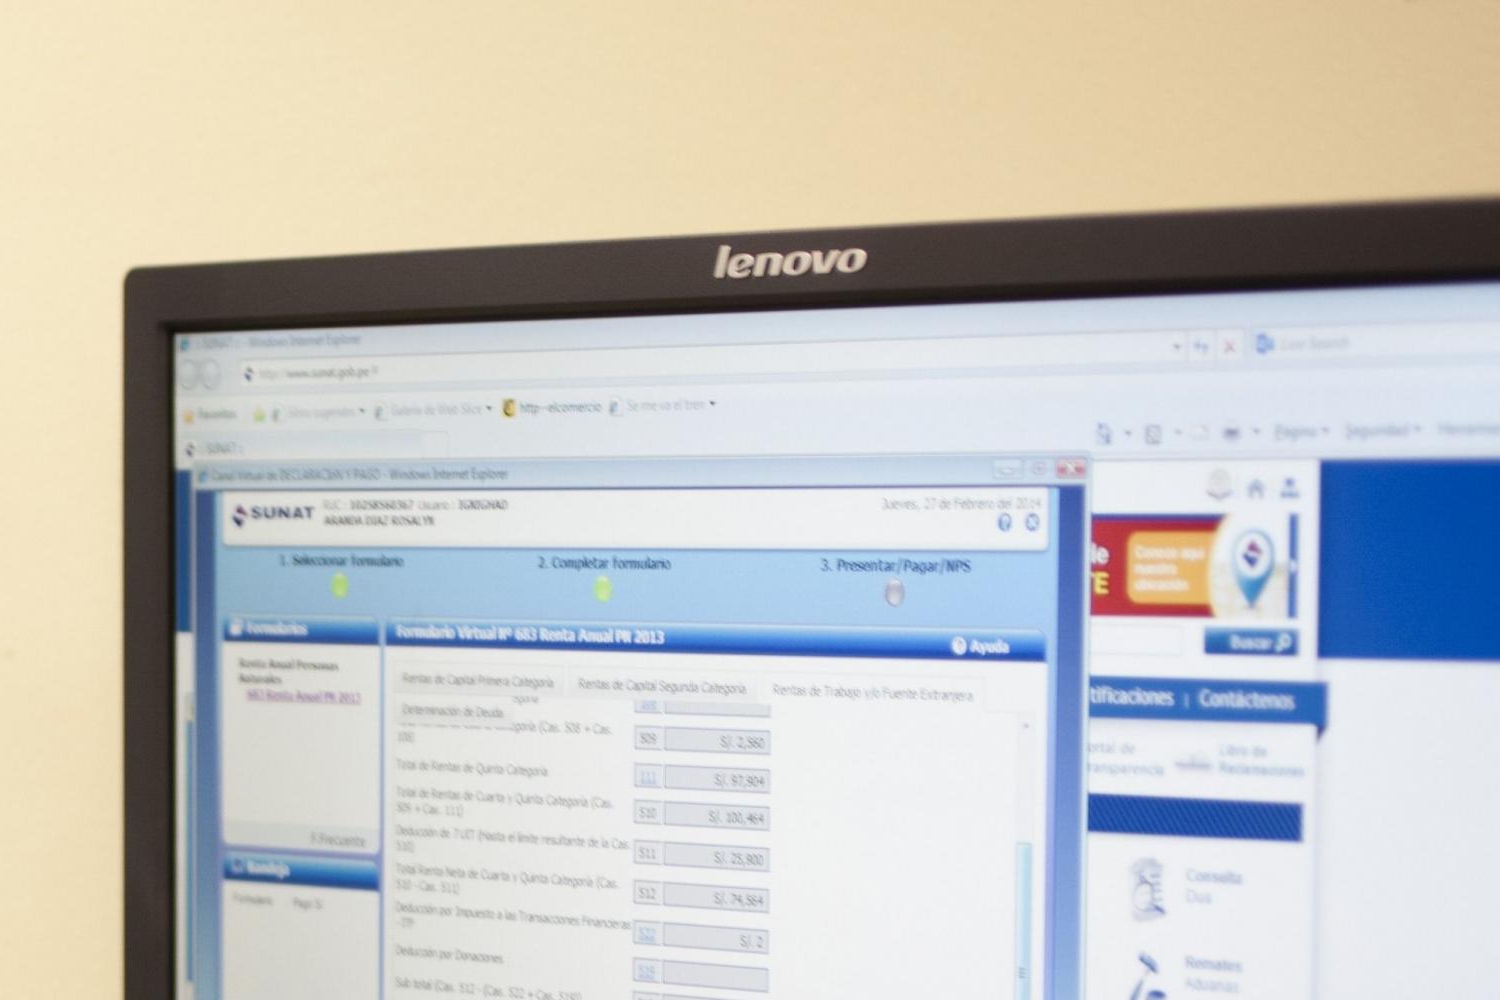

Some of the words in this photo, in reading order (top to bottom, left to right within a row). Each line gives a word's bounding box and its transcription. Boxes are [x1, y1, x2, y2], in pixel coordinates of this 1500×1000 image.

[714, 245, 867, 279] lenovo
[251, 506, 315, 519] SUNAT
[552, 556, 608, 571] Completar
[612, 558, 671, 570] formulario
[396, 624, 455, 640] Formulario
[457, 624, 496, 640] Virtual
[540, 626, 576, 642] Renta
[578, 628, 613, 643] Anual
[634, 630, 665, 644] 2013
